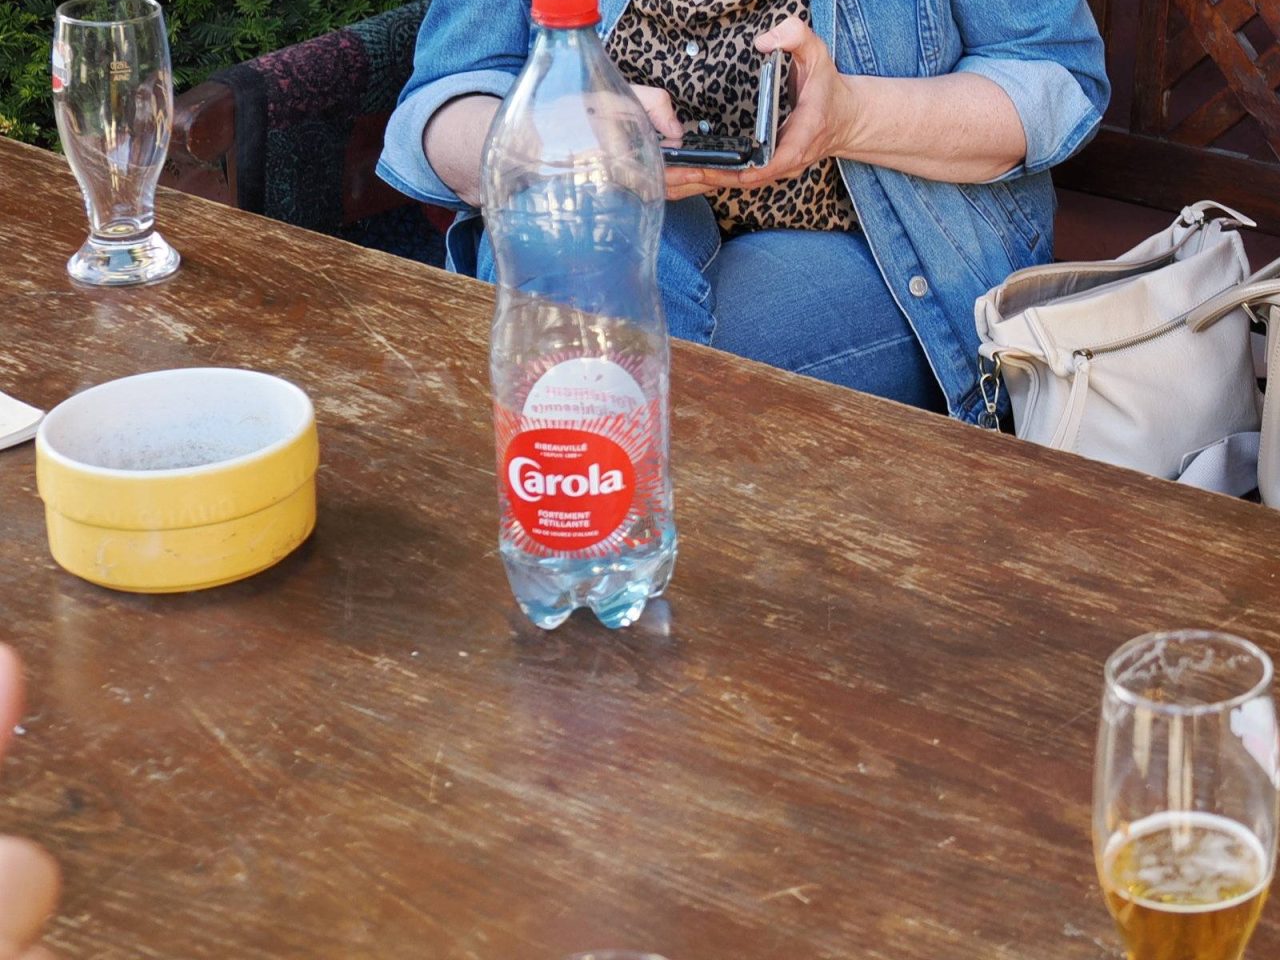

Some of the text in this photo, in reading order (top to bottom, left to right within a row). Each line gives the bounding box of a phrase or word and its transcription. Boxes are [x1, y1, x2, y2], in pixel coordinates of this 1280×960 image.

[534, 442, 588, 452] RIBEAUVILLÉ
[508, 456, 625, 502] Carola
[537, 509, 592, 519] FORTEMENT
